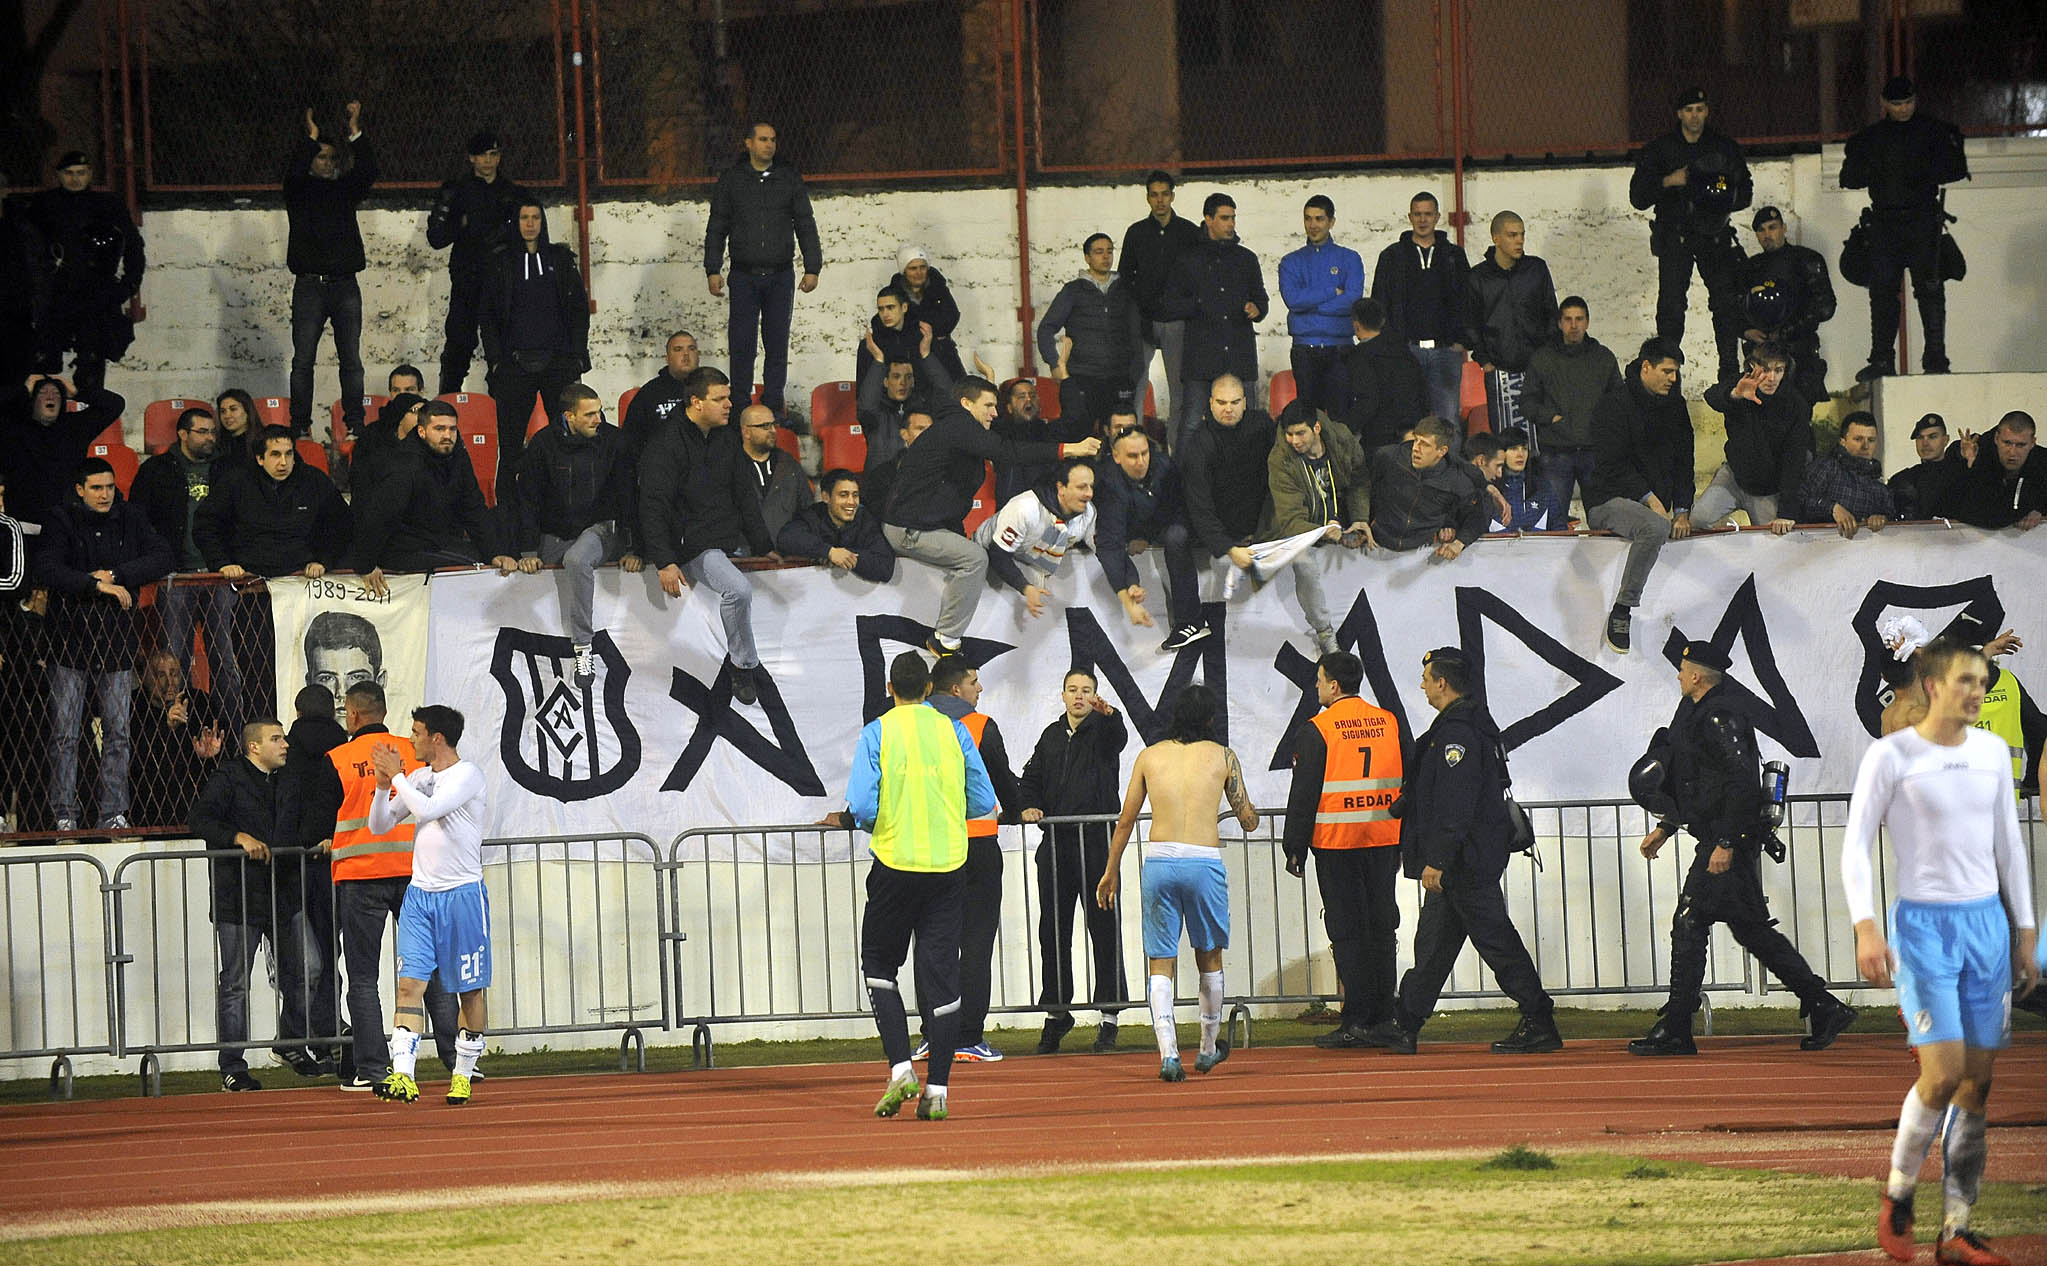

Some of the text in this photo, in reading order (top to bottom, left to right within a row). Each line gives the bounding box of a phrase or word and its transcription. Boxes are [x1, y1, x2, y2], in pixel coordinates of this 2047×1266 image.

[1334, 717, 1387, 730] BRUNO TIGAR
[1342, 728, 1385, 740] SIGURNOST
[1358, 746, 1372, 778] 7
[1343, 793, 1393, 808] REDAR
[460, 951, 480, 981] 21
